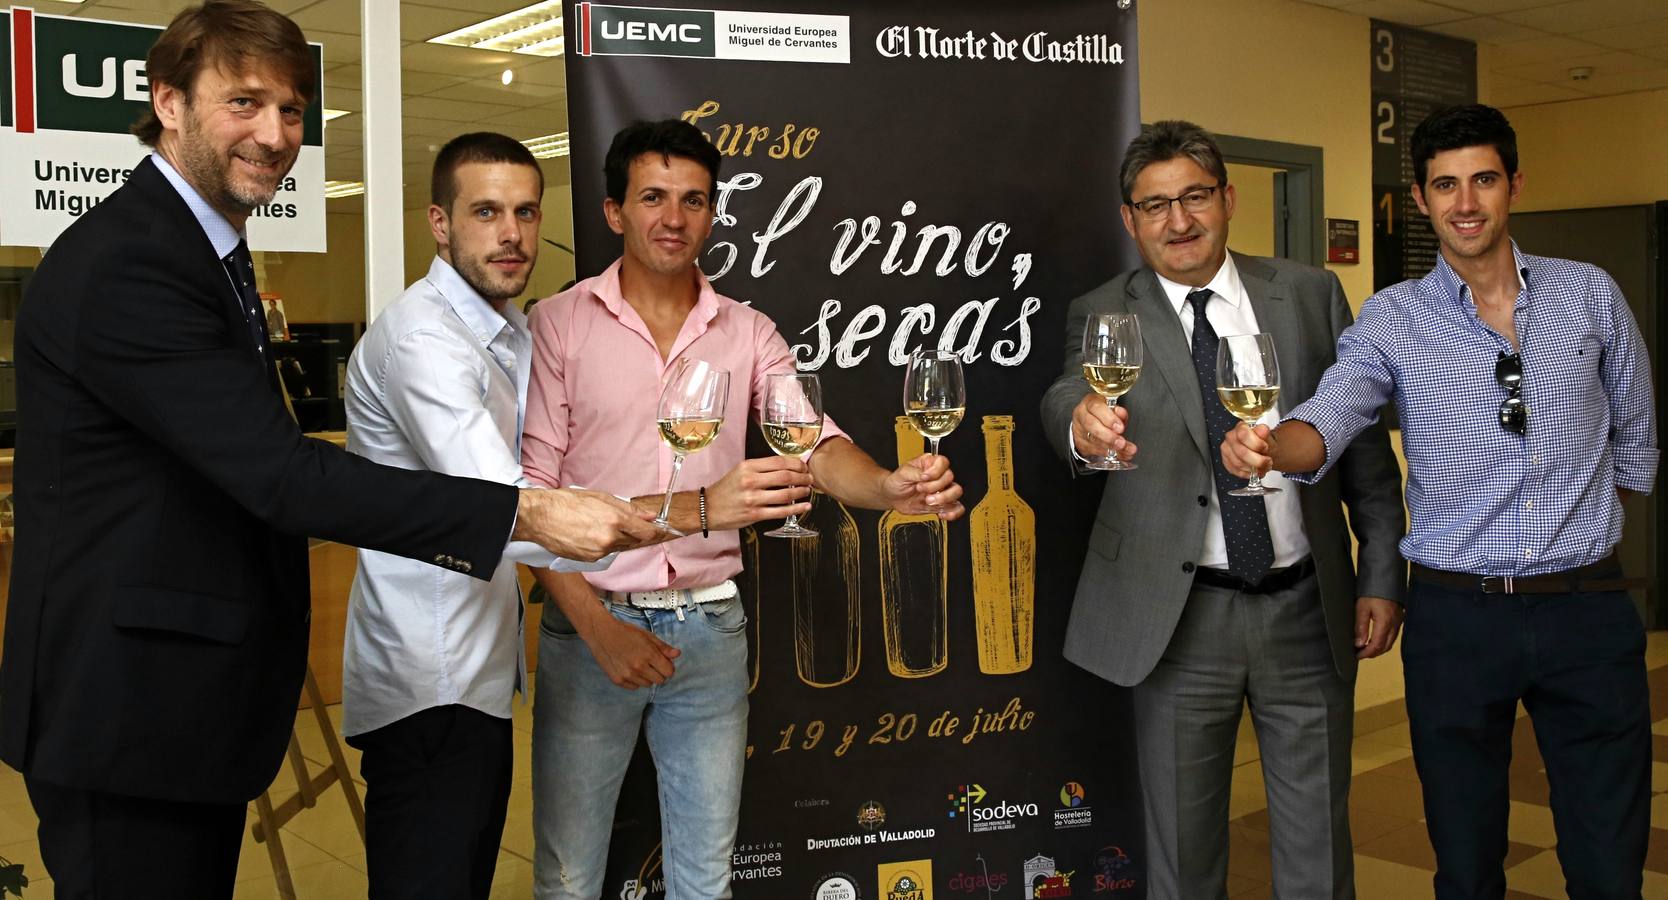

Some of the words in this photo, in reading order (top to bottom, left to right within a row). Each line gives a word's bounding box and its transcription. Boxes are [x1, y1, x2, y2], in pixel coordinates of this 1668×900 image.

[601, 20, 702, 43] UEMC
[729, 24, 791, 35] Universidad
[794, 26, 837, 38] Europea
[729, 36, 764, 47] Miguel
[768, 37, 781, 46] de
[784, 38, 838, 48] Cervantes
[876, 25, 911, 58] El
[914, 26, 987, 59] Norte
[990, 31, 1018, 61] de
[1022, 31, 1124, 64] Castilla
[1376, 30, 1394, 72] 3
[62, 53, 150, 102] UE
[1377, 101, 1395, 144] 2
[35, 160, 133, 183] Univers
[36, 189, 101, 216] Migu
[1379, 193, 1392, 234] 1
[694, 172, 822, 281] El
[830, 200, 1032, 291] vino,
[790, 297, 1041, 371] secas
[834, 724, 858, 757] y
[868, 712, 918, 745] 20
[927, 710, 960, 738] de
[962, 697, 1036, 744] julio
[972, 800, 1038, 821] sodeva
[864, 834, 877, 844] DE
[879, 828, 936, 843] VALLADOLID
[733, 851, 782, 865] Europea
[732, 865, 782, 881] rvantes
